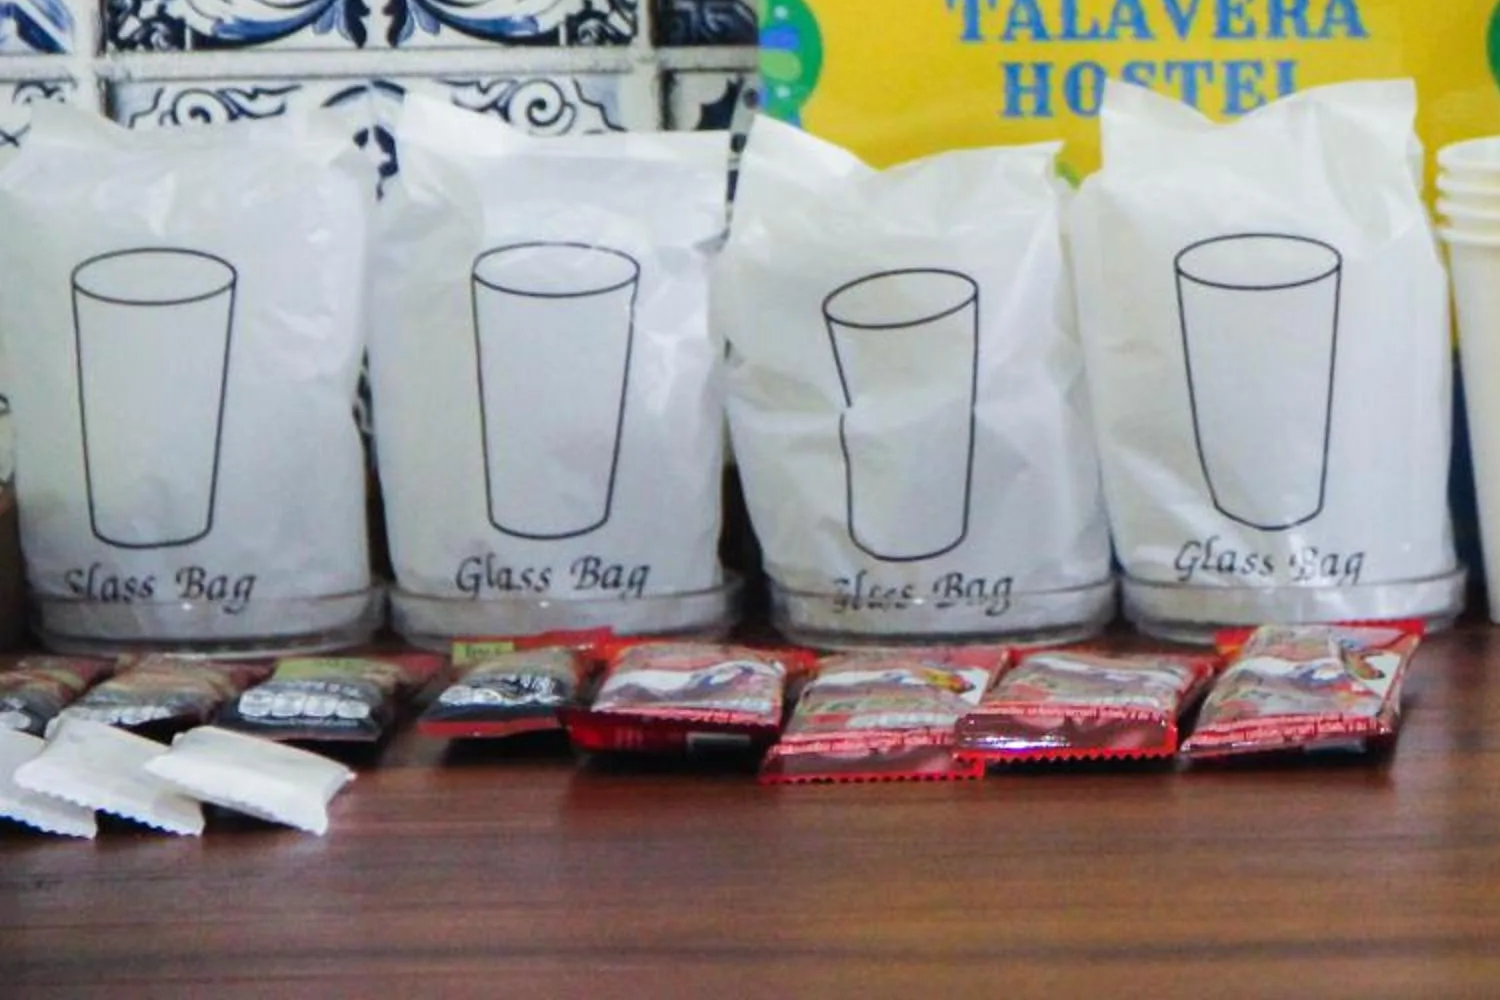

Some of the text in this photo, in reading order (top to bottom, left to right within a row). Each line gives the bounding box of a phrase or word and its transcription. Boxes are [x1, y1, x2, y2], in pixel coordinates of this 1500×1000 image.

[455, 552, 652, 601] Glass Bag
[1173, 534, 1275, 582] Glass
[176, 564, 258, 615] Bag
[932, 571, 1015, 617] Bag
